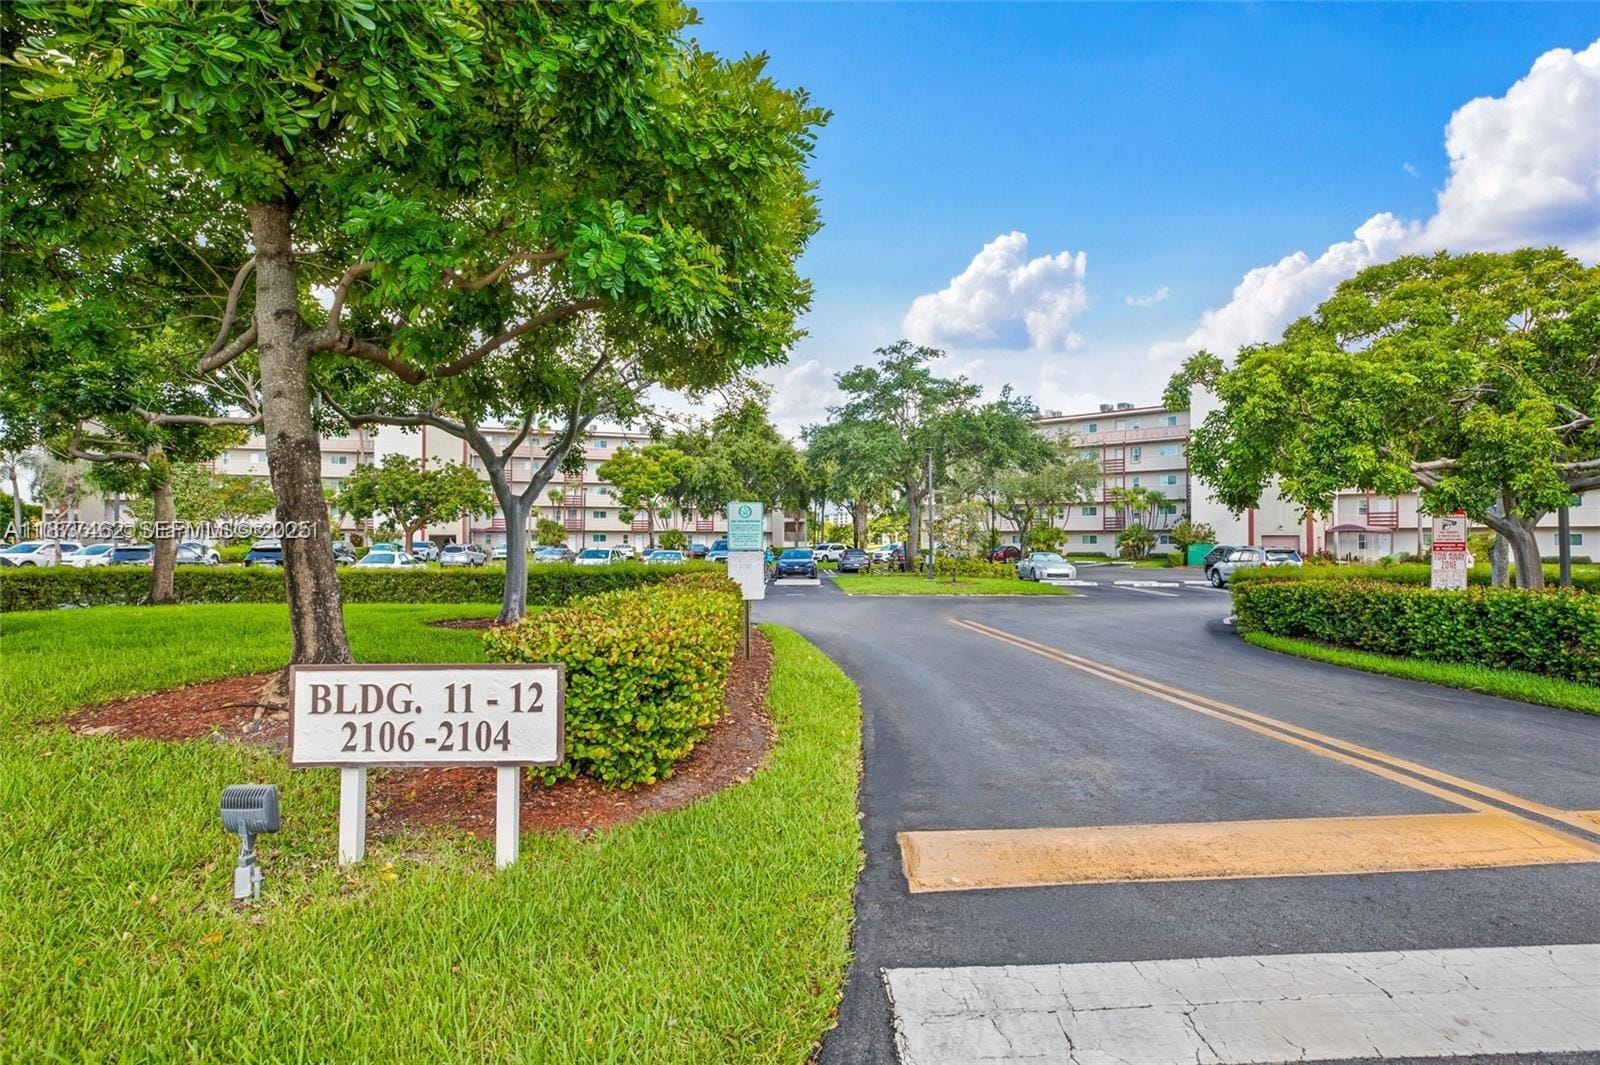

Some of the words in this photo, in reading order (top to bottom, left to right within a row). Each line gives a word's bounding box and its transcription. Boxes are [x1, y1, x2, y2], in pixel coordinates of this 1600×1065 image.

[1434, 552, 1447, 561] TOW
[1441, 560, 1457, 570] ZONE
[307, 682, 422, 715] BLDG.
[444, 682, 474, 714] 11
[509, 682, 544, 713] 12
